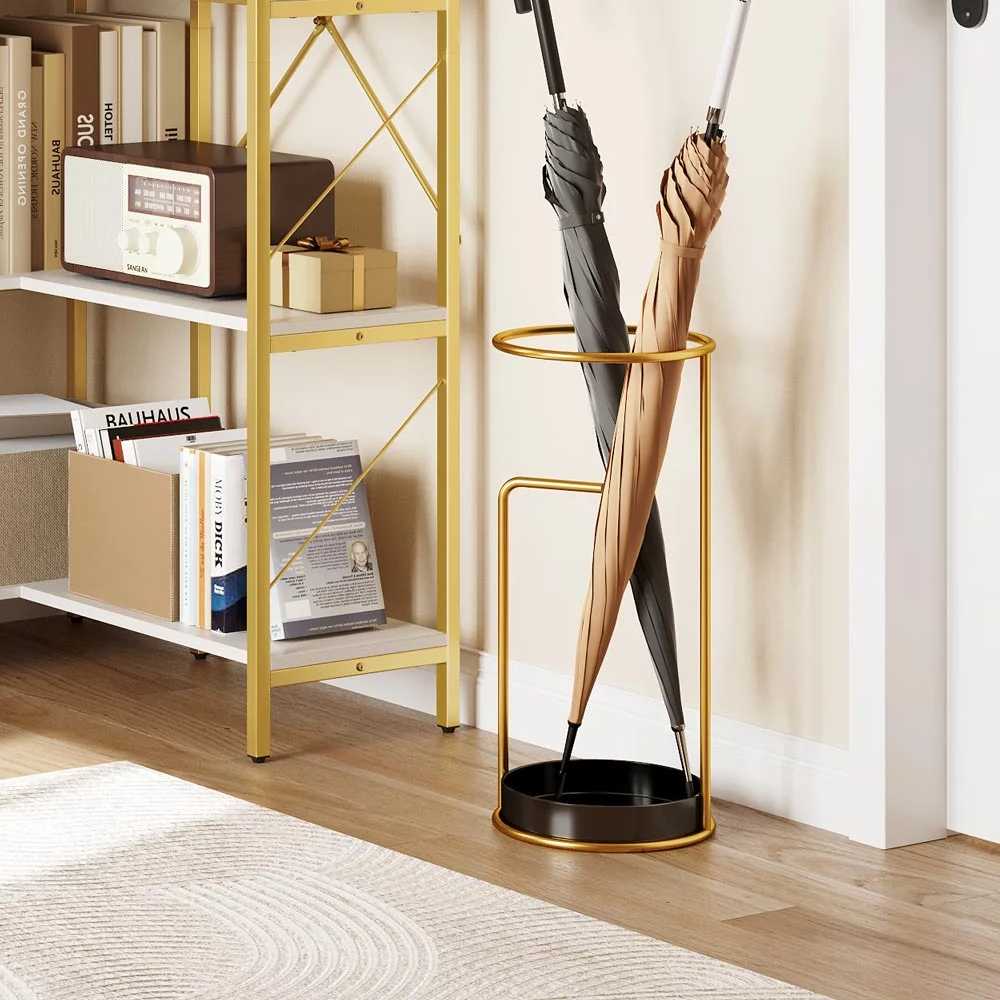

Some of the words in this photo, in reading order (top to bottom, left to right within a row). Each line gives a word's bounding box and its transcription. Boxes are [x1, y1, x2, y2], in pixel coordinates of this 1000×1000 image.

[127, 263, 149, 273] SANGEAN
[105, 406, 191, 428] BAUHAUS
[214, 478, 223, 516] MOBY
[214, 521, 223, 569] DICK
